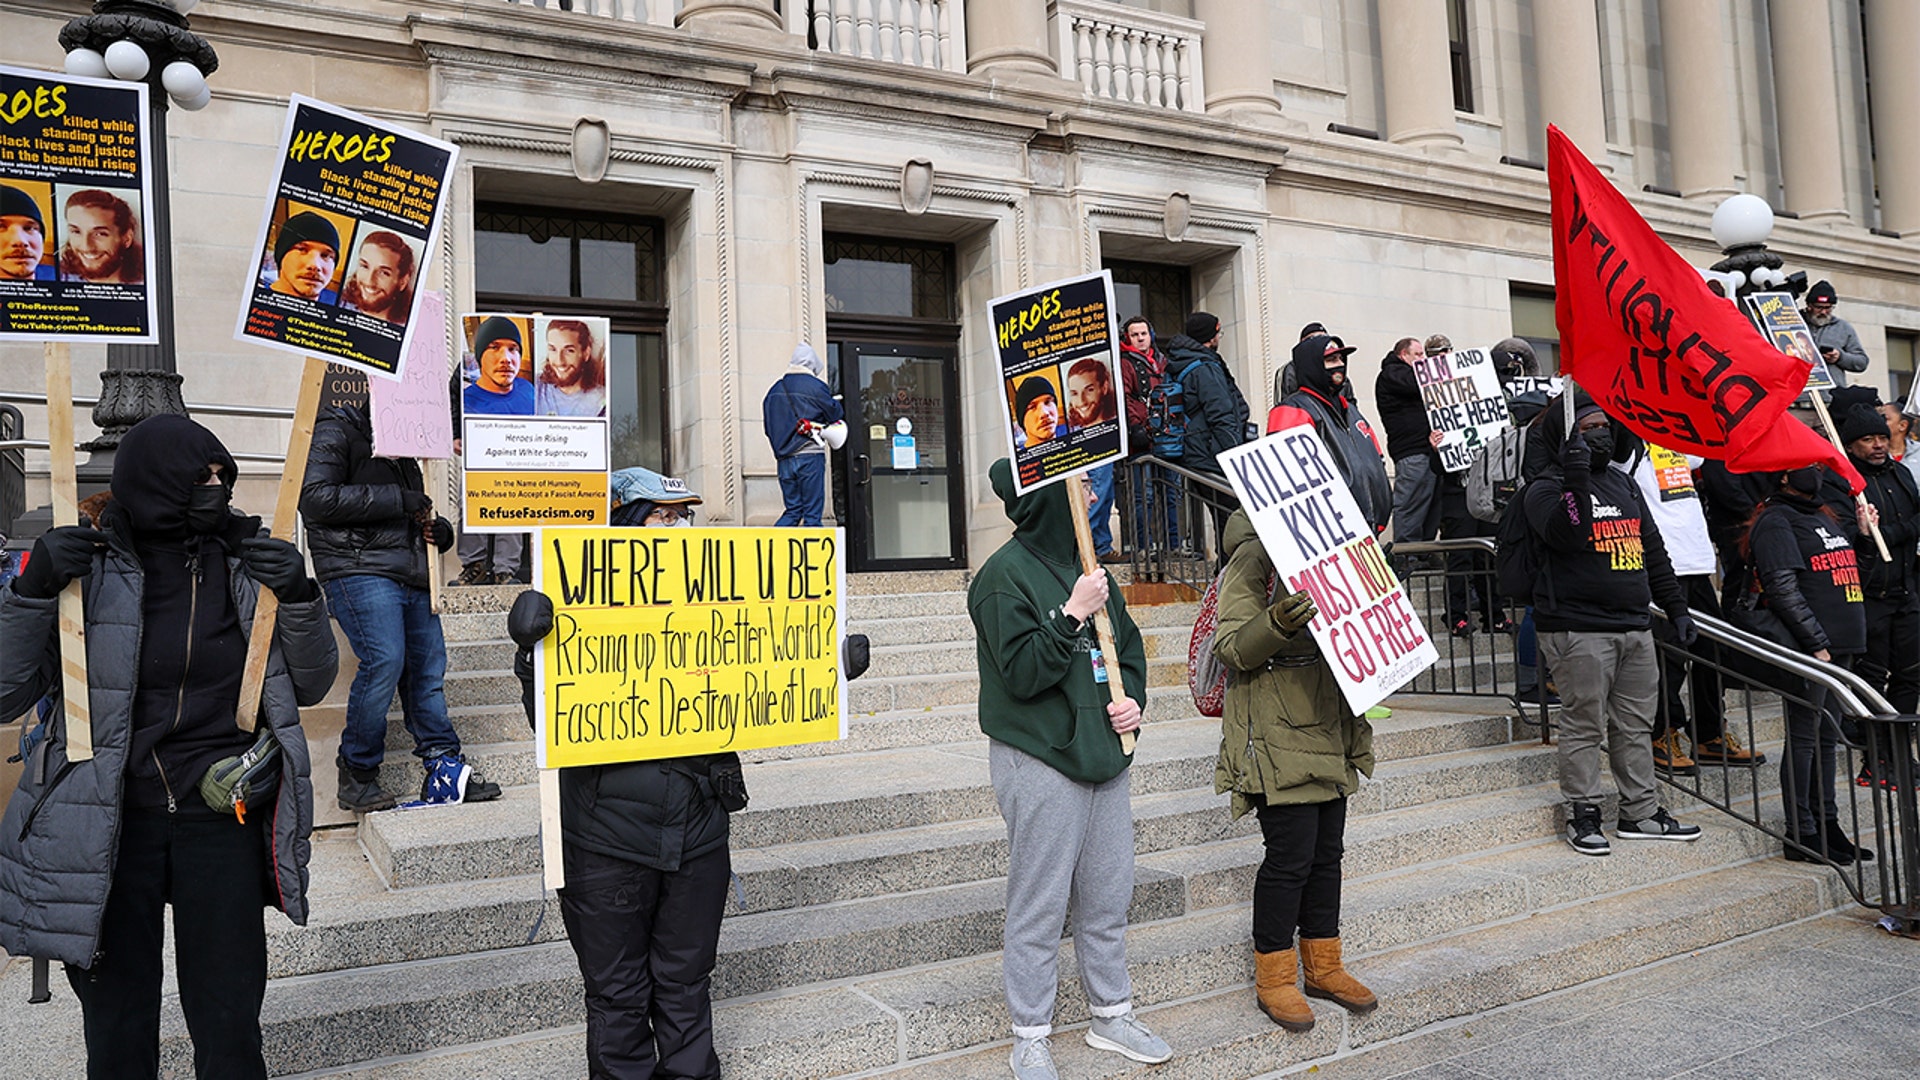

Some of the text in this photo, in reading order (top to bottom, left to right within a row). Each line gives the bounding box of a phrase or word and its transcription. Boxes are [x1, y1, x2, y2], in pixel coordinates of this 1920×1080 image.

[42, 127, 135, 145] standing up for
[63, 115, 135, 132] killed while
[2, 148, 136, 172] in the beautiful rising
[35, 139, 64, 151] lives
[68, 144, 90, 154] and
[94, 144, 136, 158] justice
[290, 130, 396, 163] HEROES
[320, 168, 433, 212] Black lives and justice
[362, 169, 436, 200] standing up for
[383, 162, 439, 189] killed while
[322, 182, 430, 226] in the beautiful rising
[7, 302, 80, 312] @TheRevcoms
[10, 314, 90, 322] www.revcom.us
[999, 290, 1061, 348] HEROES
[1060, 302, 1104, 319] killed while
[10, 322, 142, 332] YouTube.com/TheRevcoms
[249, 316, 275, 328] Read:
[286, 326, 353, 348] www.revcom.us
[251, 307, 284, 320] Follow:
[288, 316, 347, 337] @TheRevcoms
[1022, 322, 1106, 350] Black lives and justice
[1048, 312, 1105, 332] standing up for
[248, 326, 278, 338] Watch:
[284, 334, 391, 369] YouTube.com/TheRevcoms
[1028, 331, 1107, 358] in the beautiful rising
[1414, 350, 1484, 385] BLM AND
[1422, 376, 1480, 410] ANTIFA
[1430, 396, 1508, 432] ARE HERE
[505, 434, 568, 444] Heroes in Rising
[1464, 427, 1482, 448] 2
[485, 448, 588, 458] Against White Supremacy
[548, 480, 581, 489] Humanity
[1230, 434, 1334, 512] KILLER
[468, 490, 480, 498] We
[482, 490, 507, 498] Refuse
[518, 491, 542, 500] Accept
[551, 490, 576, 498] Fascist
[577, 490, 606, 498] America
[480, 507, 594, 521] RefuseFascism.org
[1279, 488, 1356, 561] KYLE
[553, 538, 672, 606] WHERE
[682, 538, 744, 602] WILL
[788, 537, 836, 600] BE?
[1288, 535, 1396, 632] MUST NOT
[555, 613, 628, 686] Rising
[635, 631, 656, 682] up
[661, 612, 691, 670] for
[711, 608, 767, 666] Better
[768, 604, 836, 662] World?
[1330, 590, 1424, 684] GO FREE
[555, 667, 838, 749] Fascists Destroy Rule of Law?
